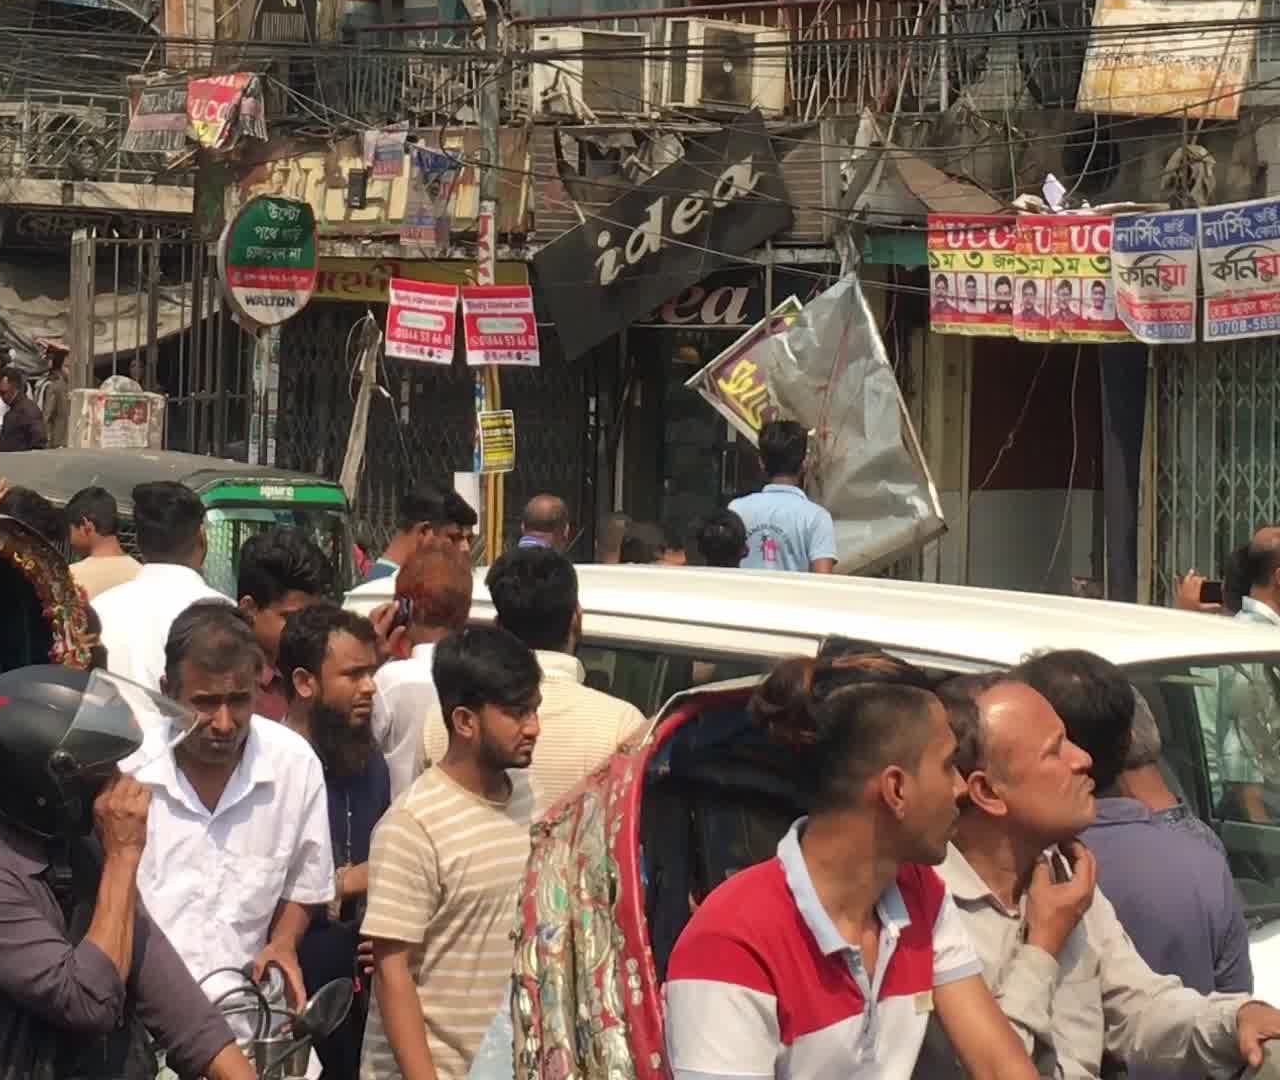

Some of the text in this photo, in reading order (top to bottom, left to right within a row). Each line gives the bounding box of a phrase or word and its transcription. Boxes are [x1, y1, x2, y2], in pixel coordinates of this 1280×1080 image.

[594, 154, 767, 286] idea
[1115, 216, 1162, 248] নার্সিং
[1203, 208, 1256, 243] নার্সিং
[1071, 224, 1112, 254] UC
[964, 251, 984, 268] ৩
[245, 295, 296, 307] WALTON
[656, 285, 751, 324] ea
